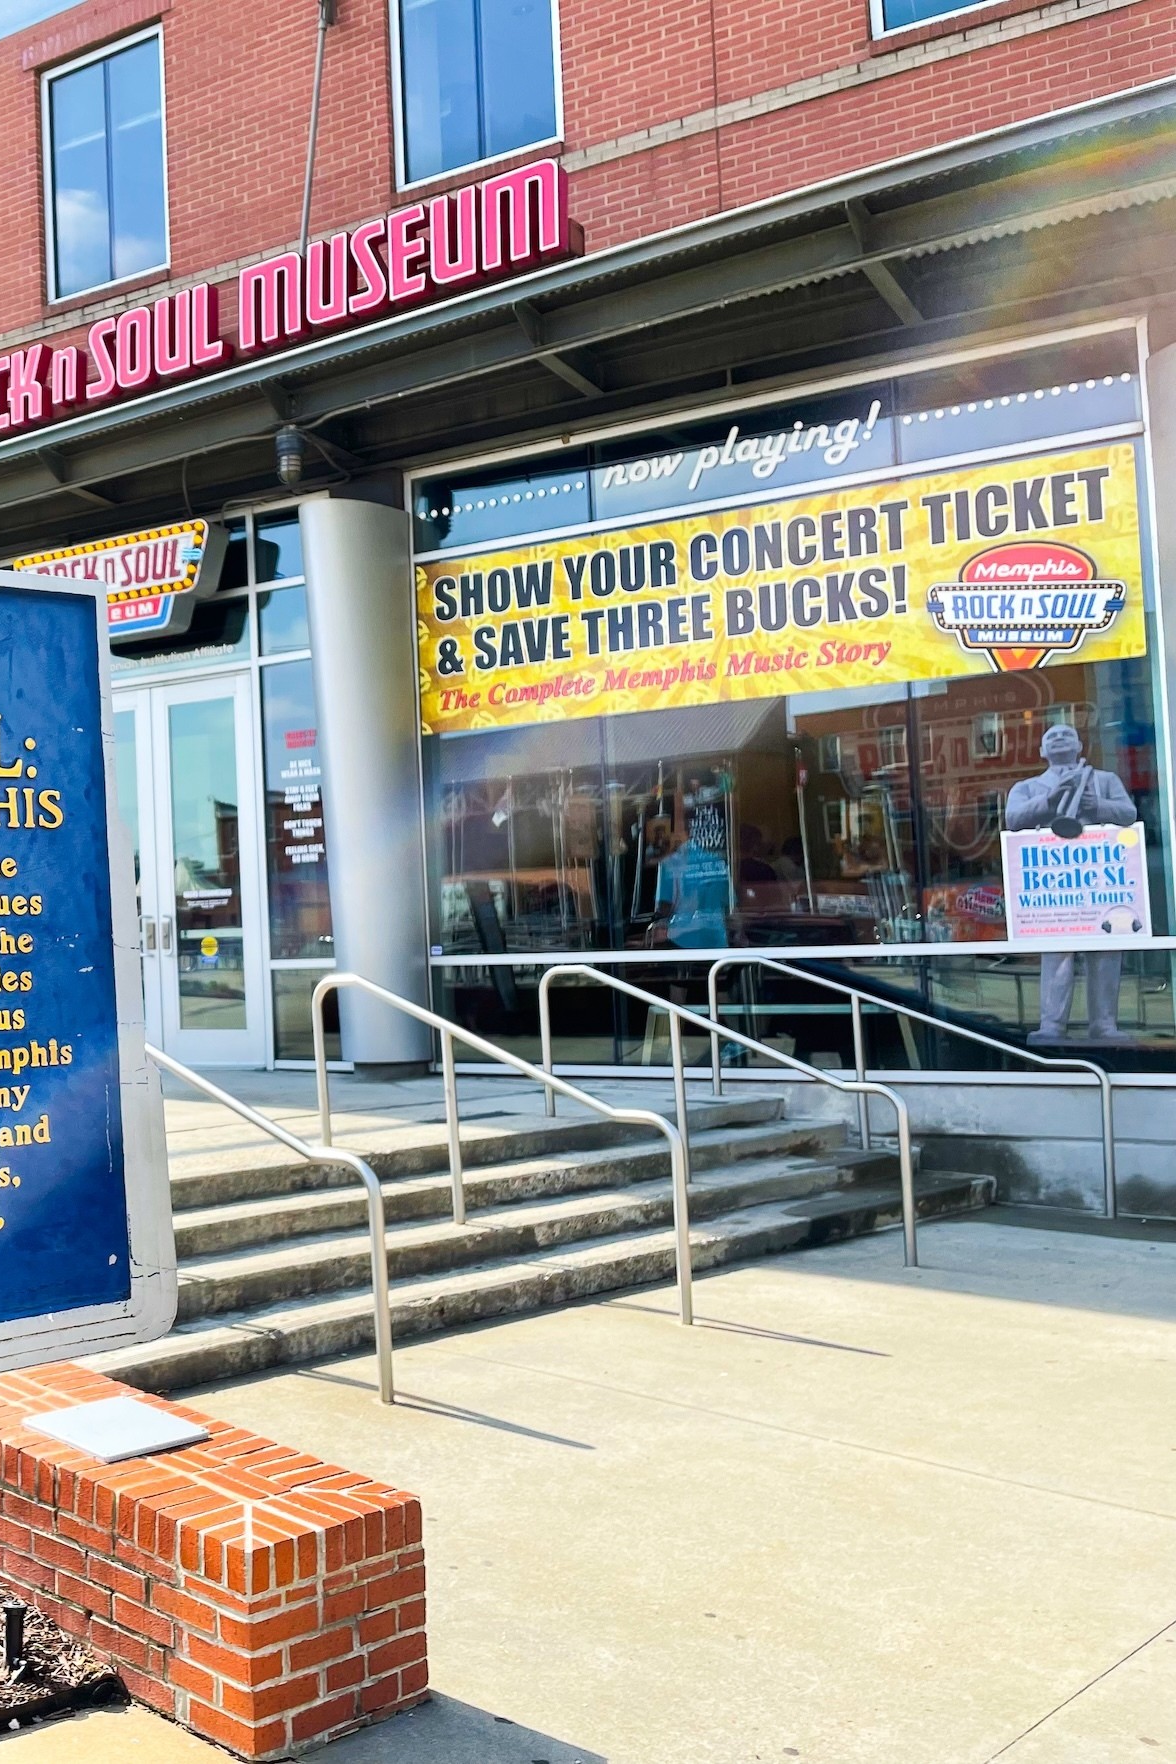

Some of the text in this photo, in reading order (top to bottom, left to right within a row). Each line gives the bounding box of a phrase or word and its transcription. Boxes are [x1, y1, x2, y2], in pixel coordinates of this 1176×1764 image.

[51, 345, 81, 402] n
[86, 282, 223, 400] SOUL
[238, 157, 560, 351] MUSEUM
[602, 400, 881, 490] now playing!
[433, 467, 1109, 620] SHOW YOUR CONCERT TICKET
[120, 539, 181, 587] SOUL
[974, 558, 1082, 583] Memphis
[437, 565, 907, 675] & SAVE THREE BUCKS!
[952, 593, 1097, 620] ROCK n SOUL
[977, 630, 1064, 642] MUSEUM
[439, 639, 891, 711] The Complete Memphis Music Story
[1021, 842, 1126, 867] Historic
[1022, 864, 1135, 891] Beale St.
[1018, 891, 1084, 908] Walking
[1089, 890, 1134, 905] Tours
[0, 1116, 50, 1146] and
